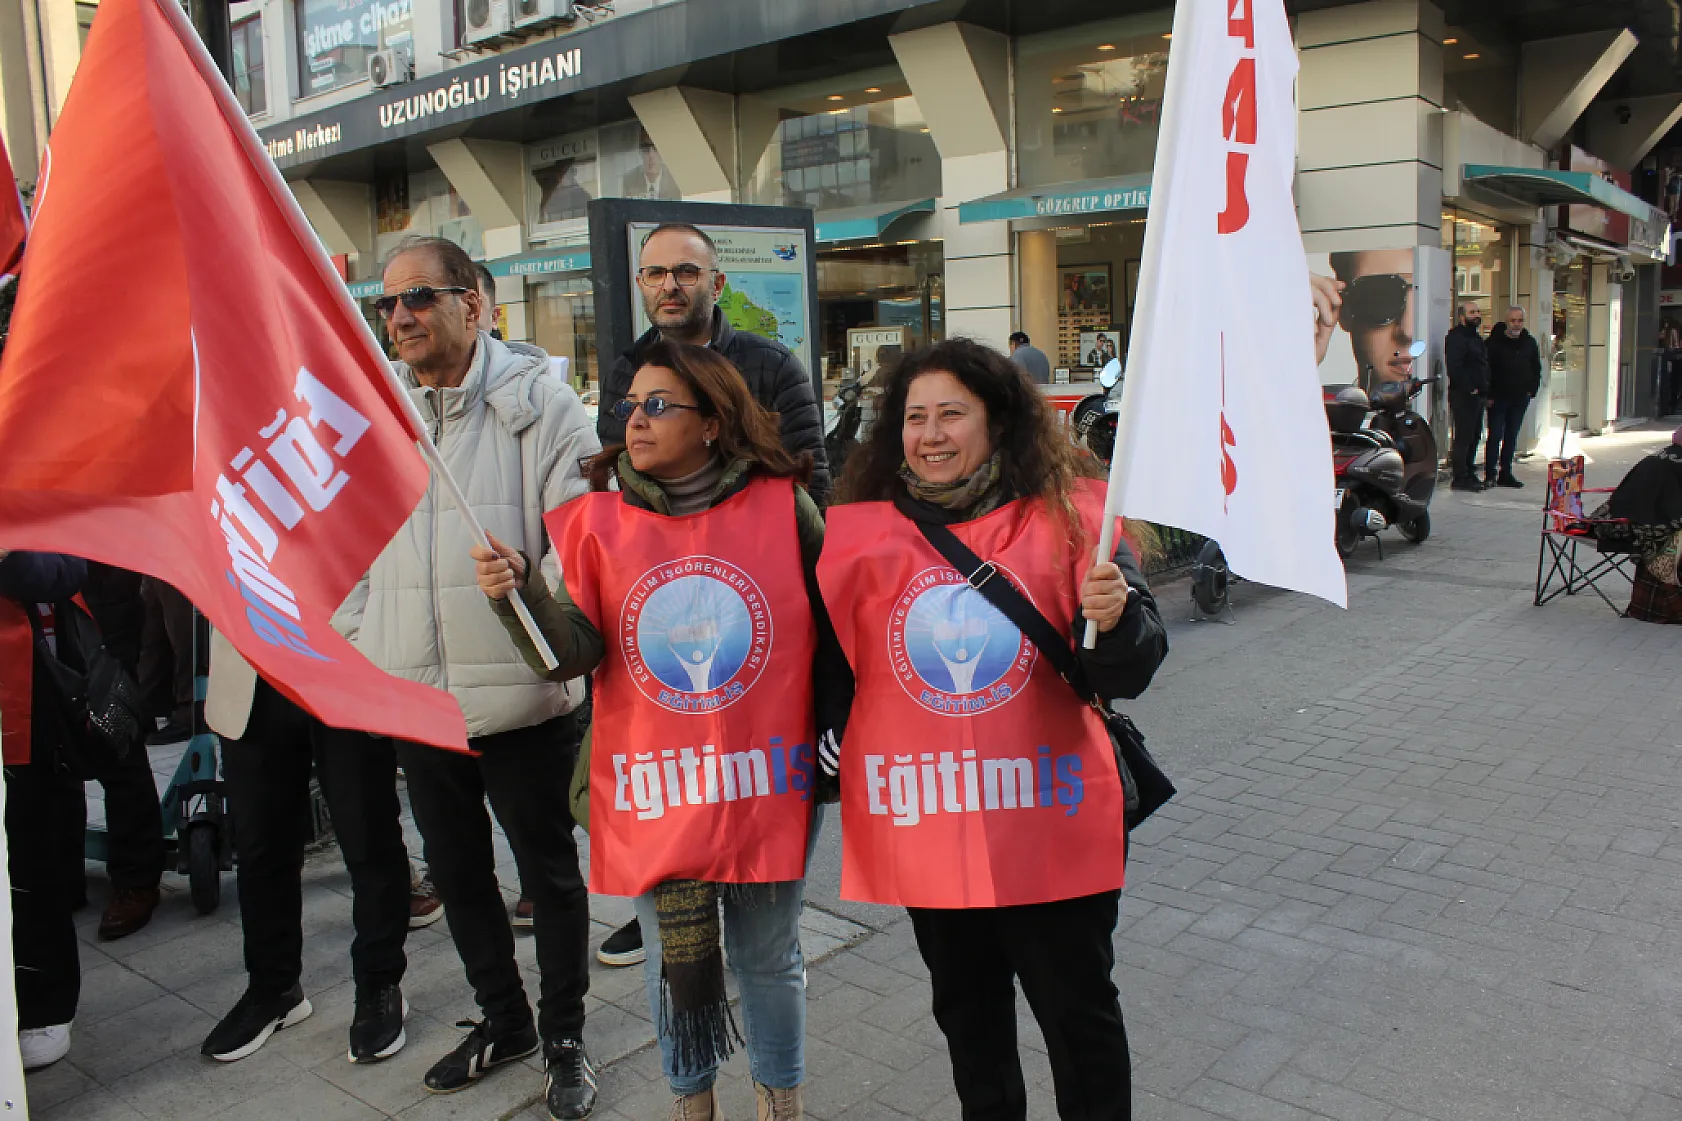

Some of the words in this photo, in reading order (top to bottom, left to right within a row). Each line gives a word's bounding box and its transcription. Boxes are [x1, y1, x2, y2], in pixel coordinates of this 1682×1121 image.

[379, 74, 490, 128] UZUNOĞLU
[499, 48, 582, 99] İŞHANI
[295, 121, 341, 153] Merkezi
[1104, 188, 1148, 207] OPTİK
[856, 332, 898, 343] GUCCI
[658, 560, 750, 592] İŞGÖRENLERİ
[630, 579, 659, 611] BİLİM
[626, 614, 636, 632] VE
[746, 593, 768, 669] SENDİKASI
[894, 608, 905, 625] VE
